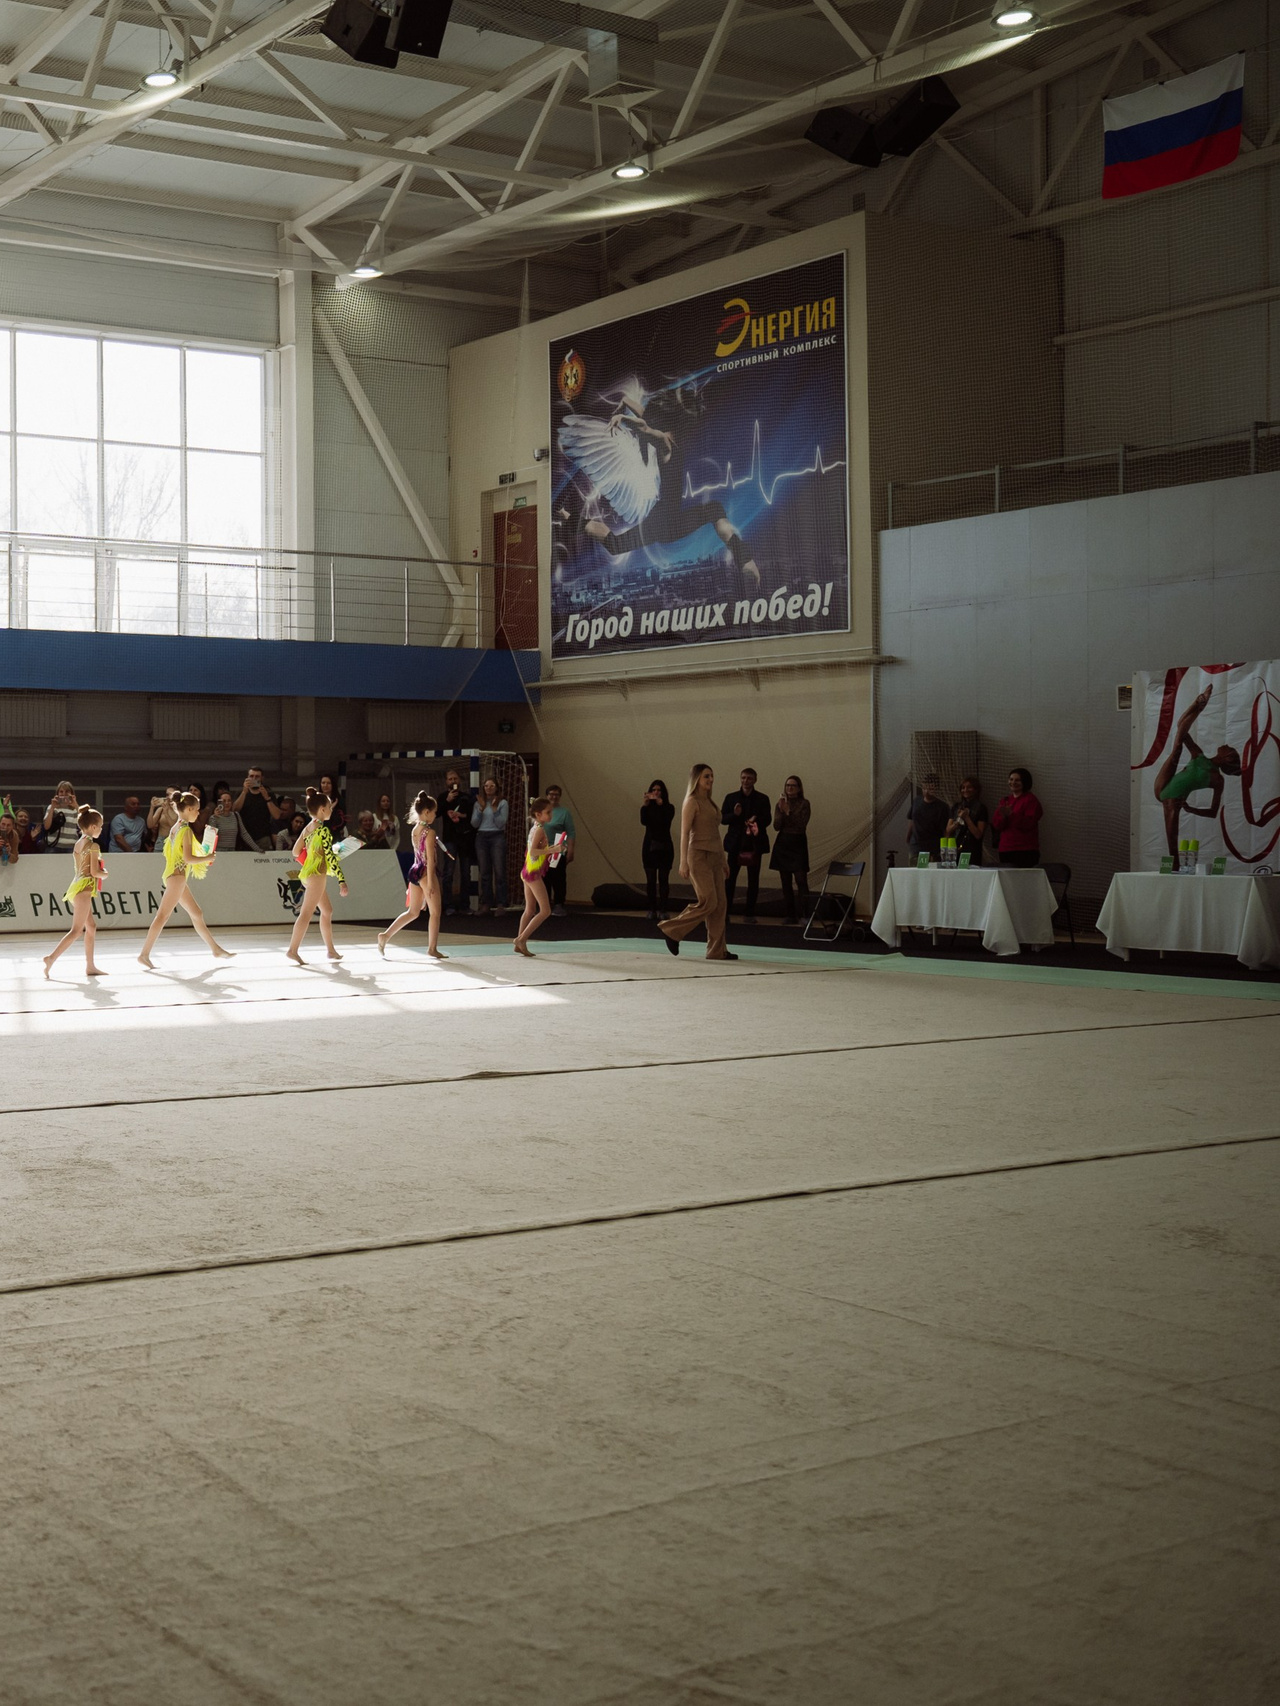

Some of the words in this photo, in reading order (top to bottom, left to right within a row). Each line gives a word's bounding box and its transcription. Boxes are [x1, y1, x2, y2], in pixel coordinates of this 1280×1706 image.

[715, 297, 836, 357] ЭНЕРГИЯ
[717, 349, 779, 373] СПОРТИВНЫЙ
[783, 335, 837, 356] КОМПЛЕКС
[565, 606, 634, 649] Город
[640, 602, 728, 635] наших
[733, 582, 834, 625] побед!
[30, 886, 177, 919] РАЦВЕТА
